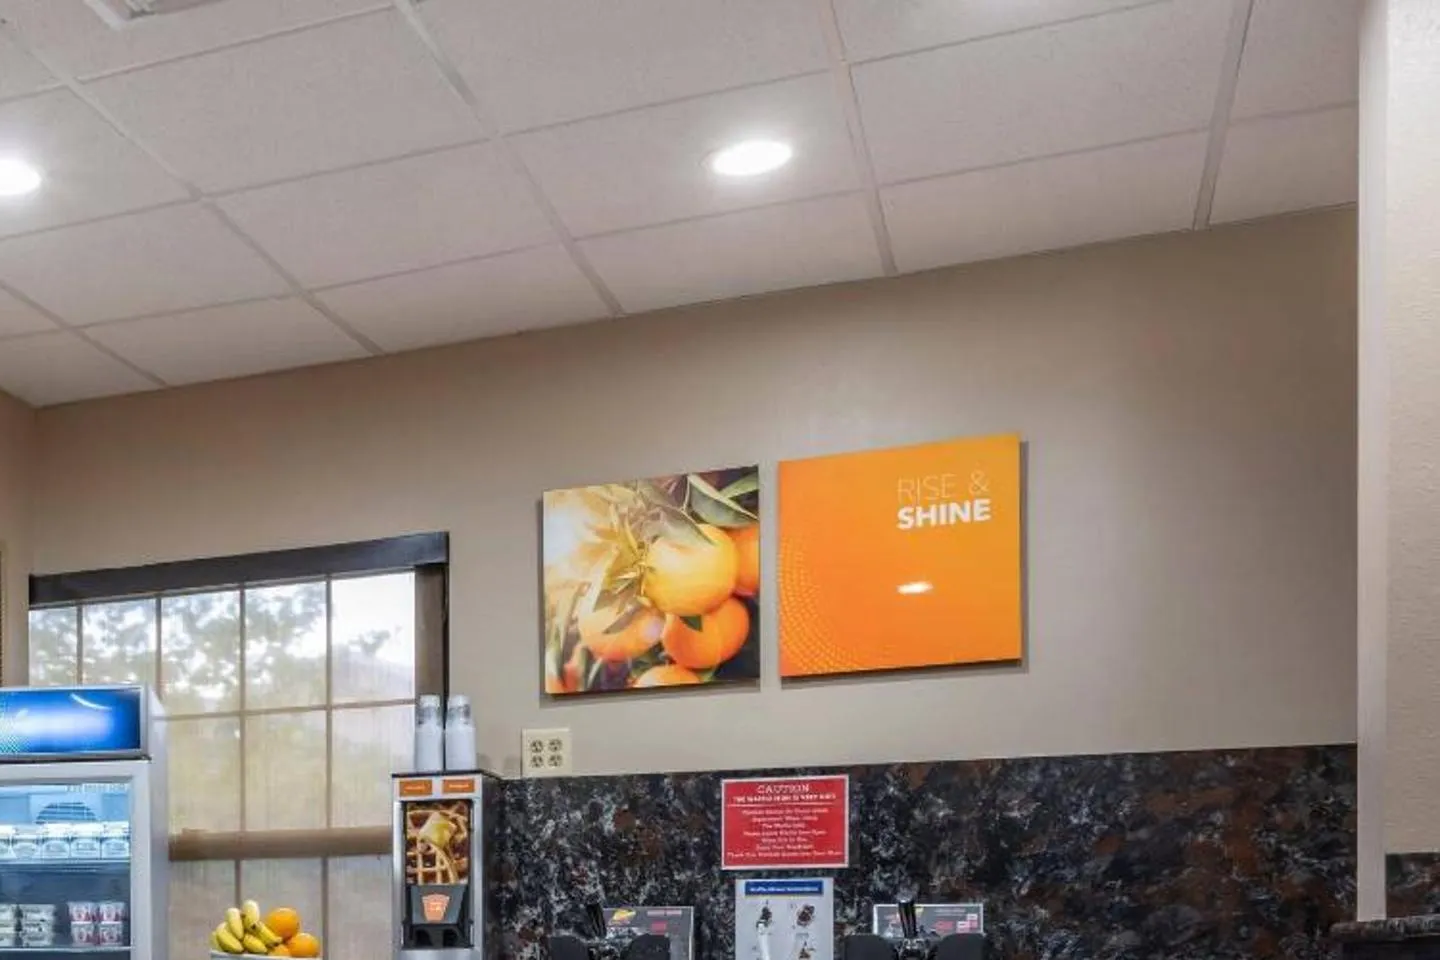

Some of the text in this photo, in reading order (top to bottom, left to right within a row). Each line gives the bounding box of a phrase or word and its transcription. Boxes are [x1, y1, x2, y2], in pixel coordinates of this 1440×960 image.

[897, 469, 991, 504] RISE &
[896, 498, 992, 531] SHINE
[757, 783, 810, 794] CAUTION
